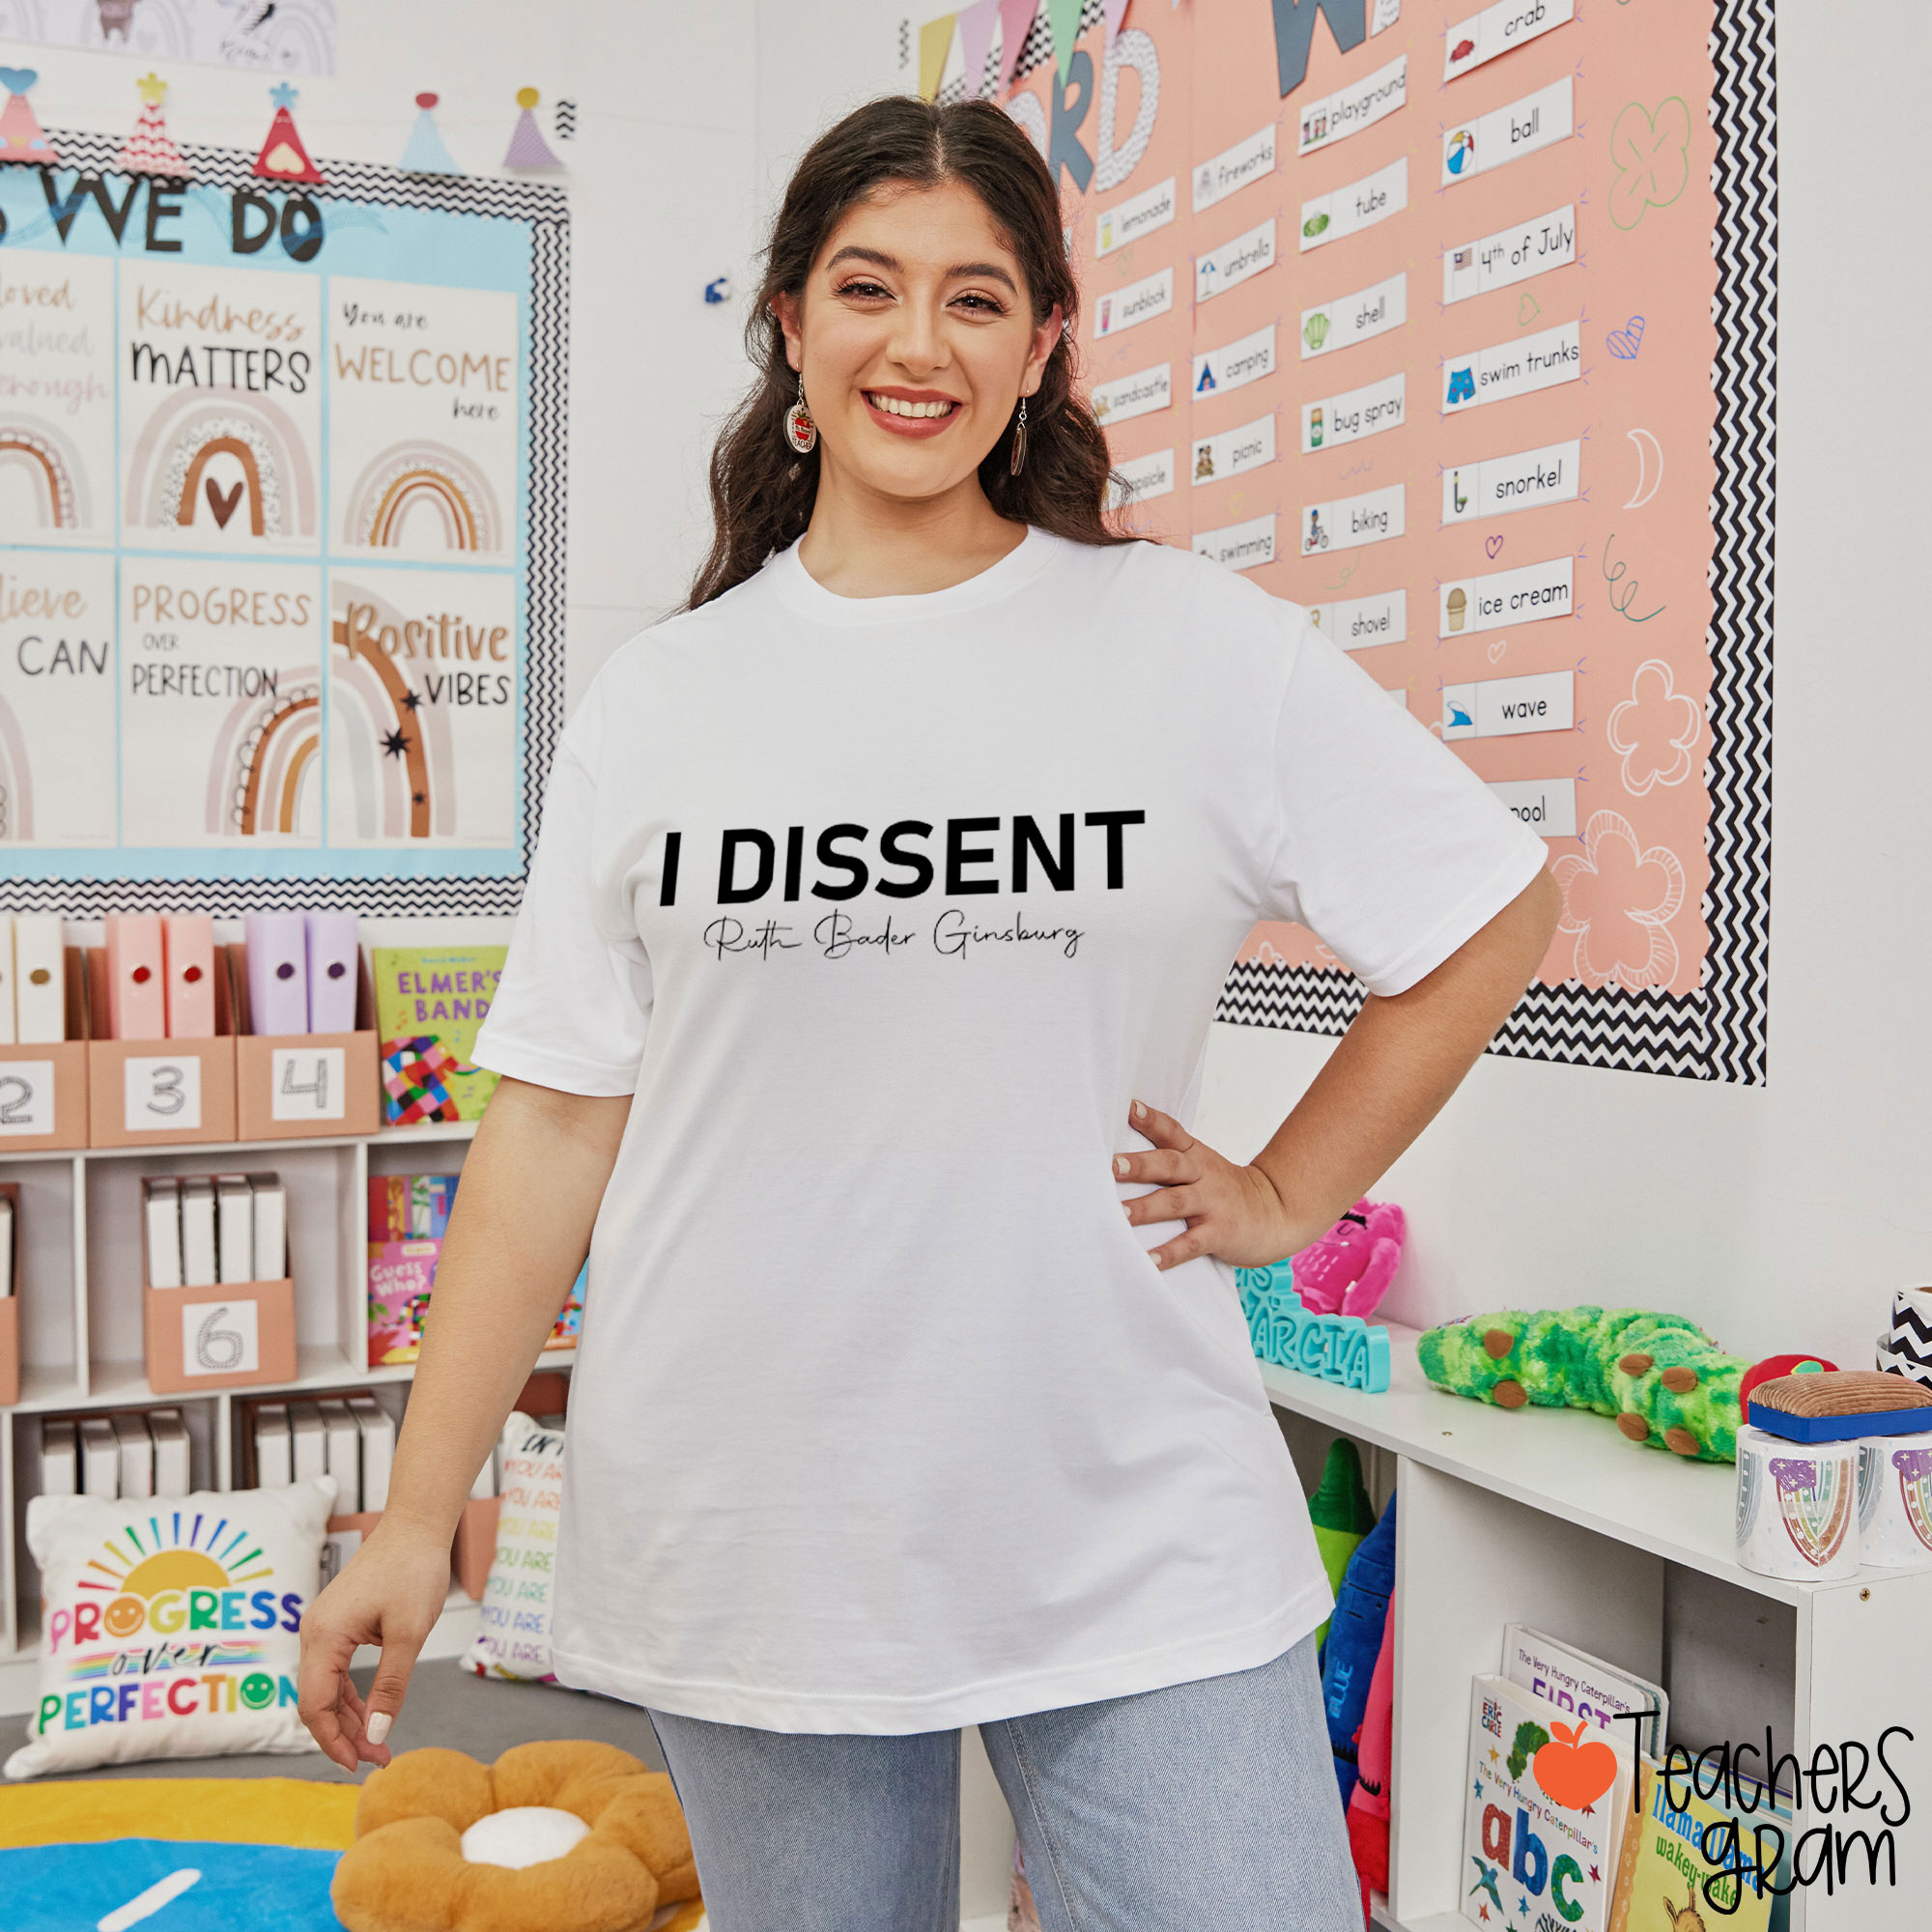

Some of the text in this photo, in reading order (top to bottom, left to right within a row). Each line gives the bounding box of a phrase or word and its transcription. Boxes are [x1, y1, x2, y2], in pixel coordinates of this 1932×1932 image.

[1504, 1, 1546, 37] crab
[1331, 64, 1406, 128] playground
[1511, 107, 1540, 144] ball
[1217, 141, 1273, 188] fireworks
[40, 172, 187, 253] WE
[232, 190, 325, 264] DO
[1121, 198, 1172, 233] lemonade
[1355, 188, 1387, 218] tube
[1224, 238, 1270, 278] umbrella
[1481, 222, 1574, 274] 4th of July
[137, 284, 306, 341] Kindness
[343, 301, 429, 330] You are
[1122, 281, 1167, 320] sunblock
[1355, 295, 1387, 330] shell
[132, 342, 310, 393] MATTERS
[334, 342, 511, 392] WELCOME
[1225, 348, 1269, 379] camping
[1480, 340, 1579, 386] swim trunks
[452, 397, 499, 420] here
[1113, 375, 1169, 409] sandcastle
[1333, 397, 1402, 433] bug spray
[1232, 439, 1264, 468] picnic
[1495, 459, 1562, 498] snorkel
[1351, 509, 1388, 533] biking
[1220, 535, 1272, 563] swimming
[132, 583, 312, 627] PROGRESS
[1478, 582, 1569, 616] ice cream
[346, 601, 509, 662] Positive
[1350, 607, 1391, 637] shovel
[17, 636, 108, 676] CAN
[144, 633, 180, 651] OVER
[131, 663, 278, 697] PERFECTION
[425, 672, 511, 706] VIBES
[1501, 696, 1548, 721] wave
[660, 810, 1146, 907] I DISSENT
[703, 908, 1085, 961] Ruth Bader Ginsburg
[0, 1075, 34, 1124] 2
[147, 1065, 185, 1115] 3
[281, 1059, 327, 1109] 4
[370, 1261, 423, 1283] Guess
[374, 1272, 427, 1297] Who?
[197, 1306, 244, 1370] 6
[1243, 1300, 1370, 1387] ARCIA
[497, 1547, 521, 1567] OU
[50, 1587, 302, 1654] PROGRESS
[111, 1639, 251, 1677] over
[1328, 1660, 1353, 1719] BLUE
[1519, 1648, 1631, 1715] The Very Hungry Caterpillar's
[39, 1672, 298, 1736] PERFECTION
[1483, 1700, 1503, 1725] ERIC
[1481, 1715, 1502, 1739] CARLE
[1479, 1761, 1599, 1855] The Very Hungry Caterpillar's
[1482, 1803, 1584, 1923] abc
